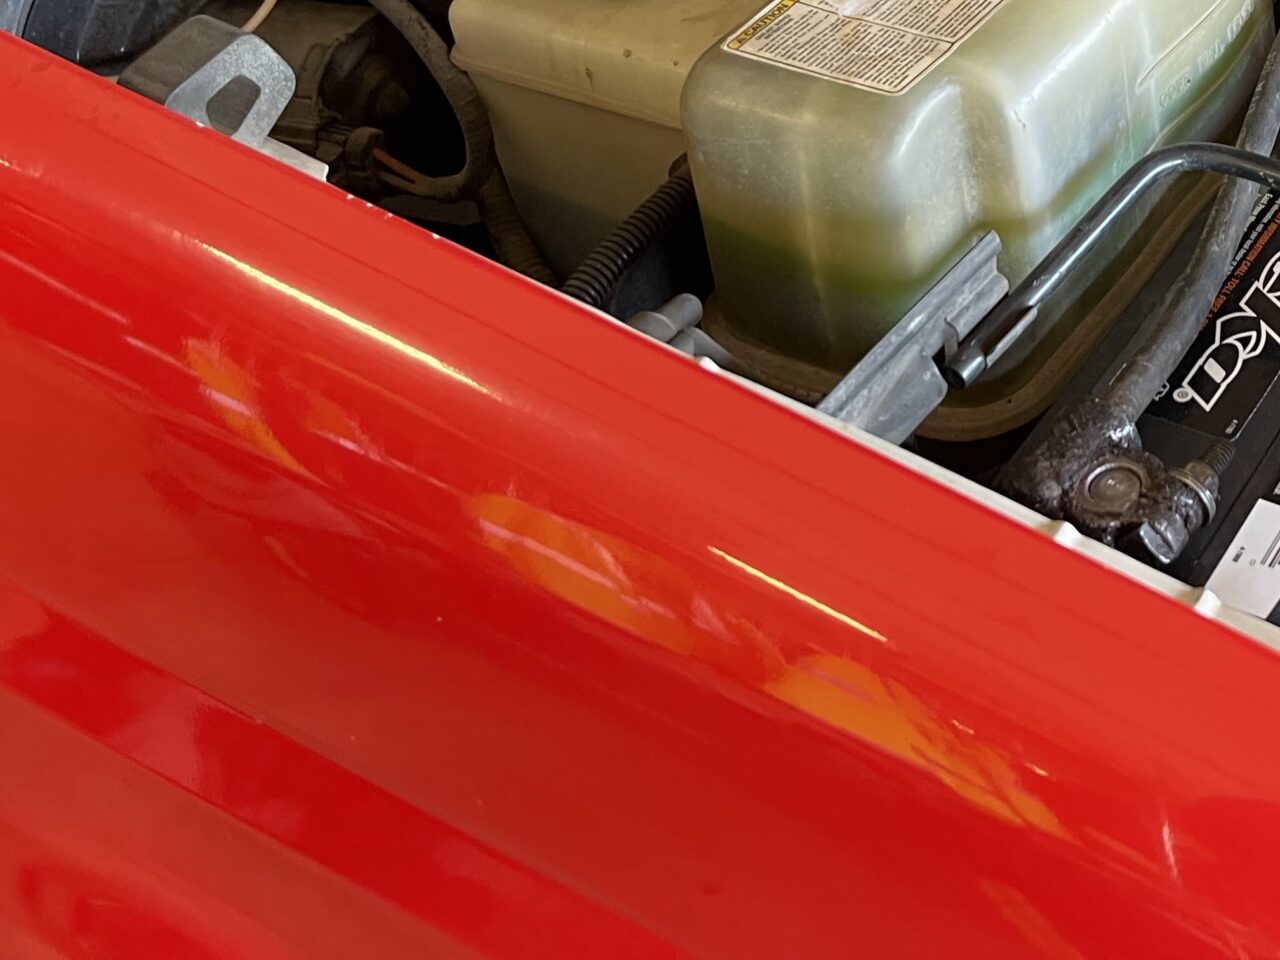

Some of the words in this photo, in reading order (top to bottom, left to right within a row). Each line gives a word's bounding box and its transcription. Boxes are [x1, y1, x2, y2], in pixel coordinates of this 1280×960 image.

[741, 3, 789, 36] CAUTION
[1246, 221, 1279, 262] INFORMATION
[1234, 259, 1251, 279] CALL:
[1221, 276, 1239, 297] TOLL
[1209, 293, 1226, 313] FREE
